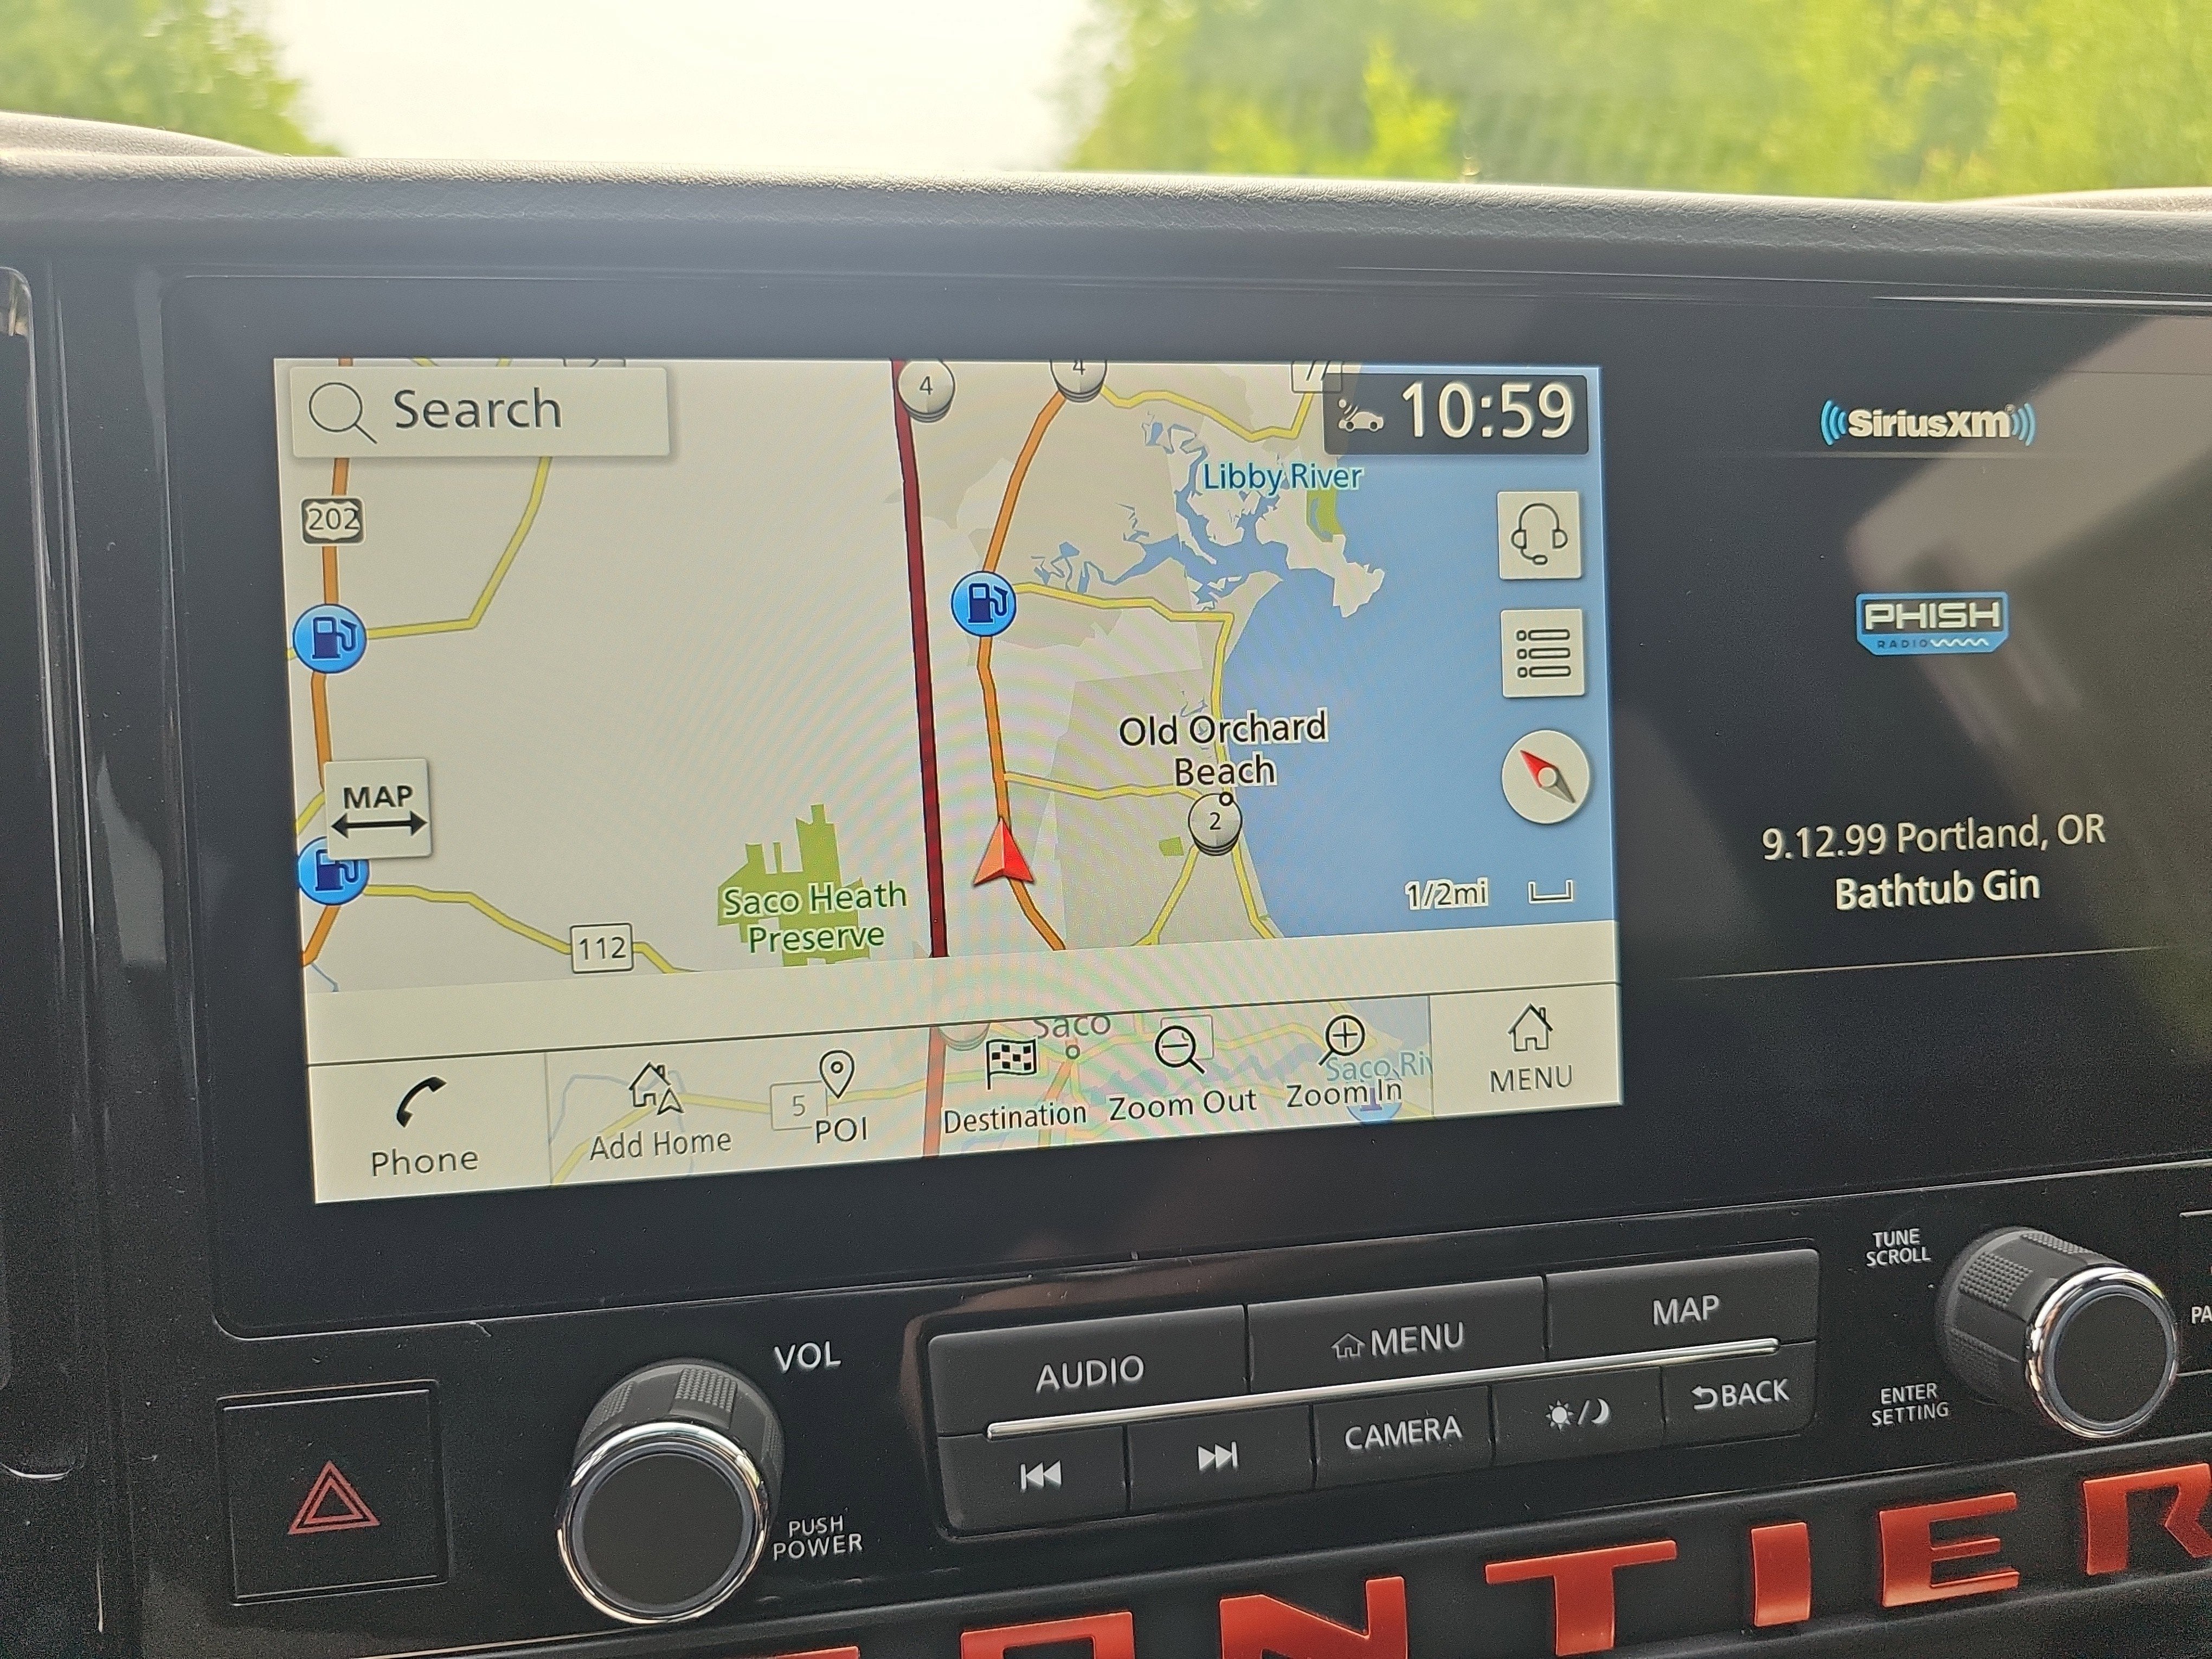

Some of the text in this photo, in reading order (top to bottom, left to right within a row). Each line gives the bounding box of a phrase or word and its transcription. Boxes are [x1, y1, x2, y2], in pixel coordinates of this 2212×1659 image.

[919, 376, 933, 395] 4
[394, 387, 562, 429] Search
[1402, 381, 1573, 439] 10:59
[1203, 462, 1362, 496] Libby River
[308, 508, 360, 531] 202
[1864, 602, 2000, 630] PHISH
[1877, 639, 1928, 650] RADIO
[1119, 710, 1327, 745] Old Orchard
[1175, 754, 1275, 786] Beach
[343, 785, 414, 809] MAP
[1208, 812, 1221, 831] 2
[1762, 813, 2106, 861] 9.12.99 Portland, OR
[724, 882, 906, 916] Saco Heath
[1407, 879, 1488, 908] 1/2mi
[1836, 869, 2041, 911] Bathtub Gin
[580, 937, 626, 961] 112
[750, 925, 885, 953] Preserve
[1326, 1056, 1391, 1081] Saco
[1490, 1064, 1573, 1093] MENU
[792, 1095, 805, 1116] 5
[1110, 1089, 1257, 1121] Zoom Out
[1287, 1078, 1401, 1108] Zoom In
[815, 1117, 868, 1143] POI
[944, 1101, 1087, 1134] Destination
[590, 1130, 732, 1161] Add Home
[372, 1148, 479, 1176] Phone
[1872, 1228, 1921, 1249] TUNE
[1866, 1245, 1932, 1268] SCROLL
[1652, 1295, 1720, 1326] MAP
[1370, 1321, 1464, 1357] MENU
[774, 1341, 841, 1373] VOL
[1036, 1355, 1144, 1393] AUDIO
[1721, 1378, 1790, 1408] BACK
[1881, 1382, 1938, 1405] ENTER
[1872, 1402, 1950, 1427] SETTING
[1344, 1414, 1463, 1452] CAMERA
[789, 1515, 844, 1538] PUSH
[773, 1533, 863, 1561] POWER
